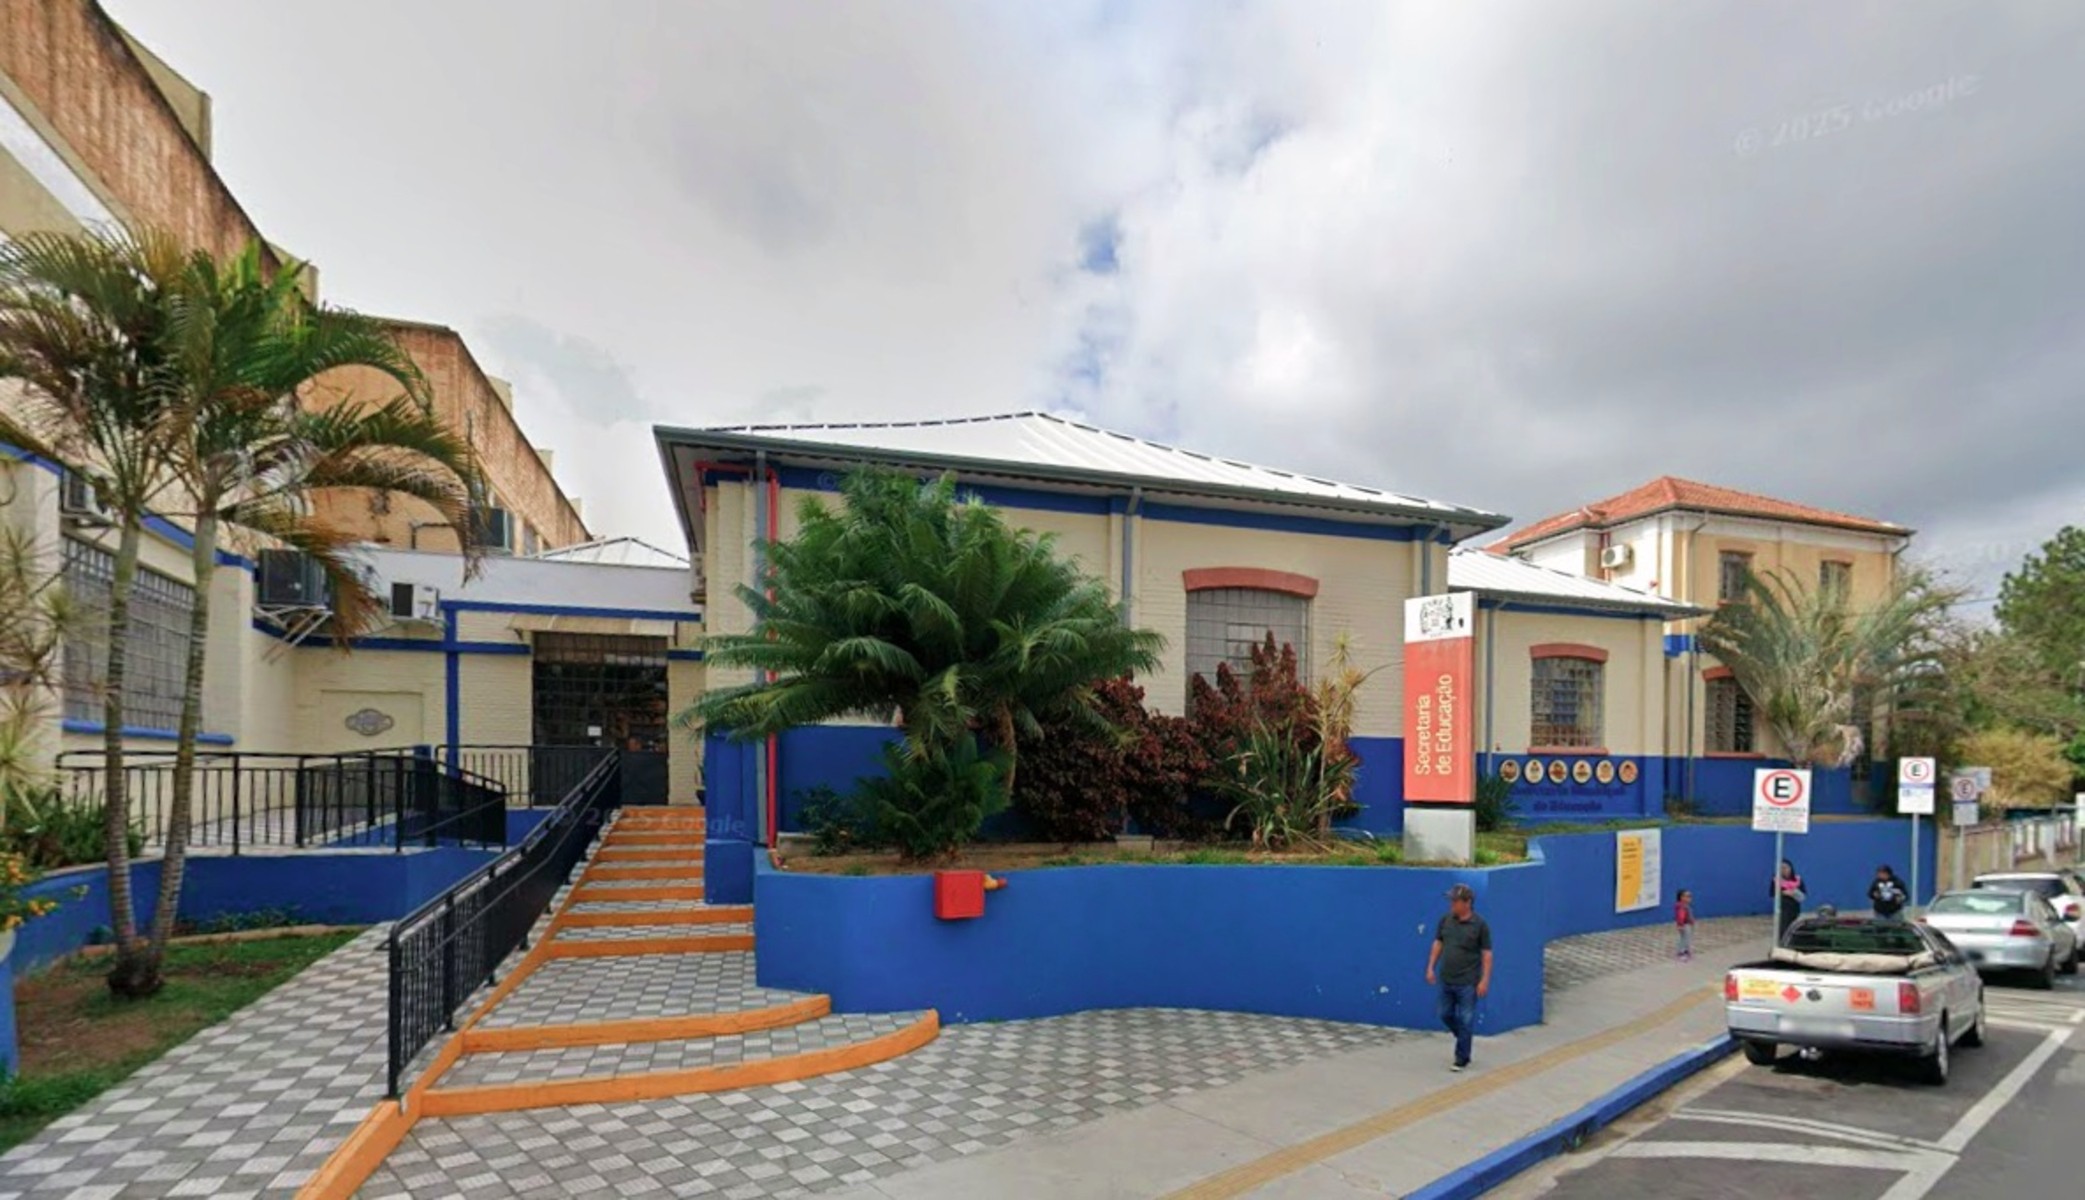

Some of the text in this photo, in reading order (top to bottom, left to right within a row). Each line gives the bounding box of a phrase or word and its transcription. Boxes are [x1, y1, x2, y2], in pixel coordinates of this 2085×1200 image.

[1415, 694, 1431, 775] Secretaria
[1435, 674, 1457, 775] de Educação
[1773, 777, 1791, 799] E
